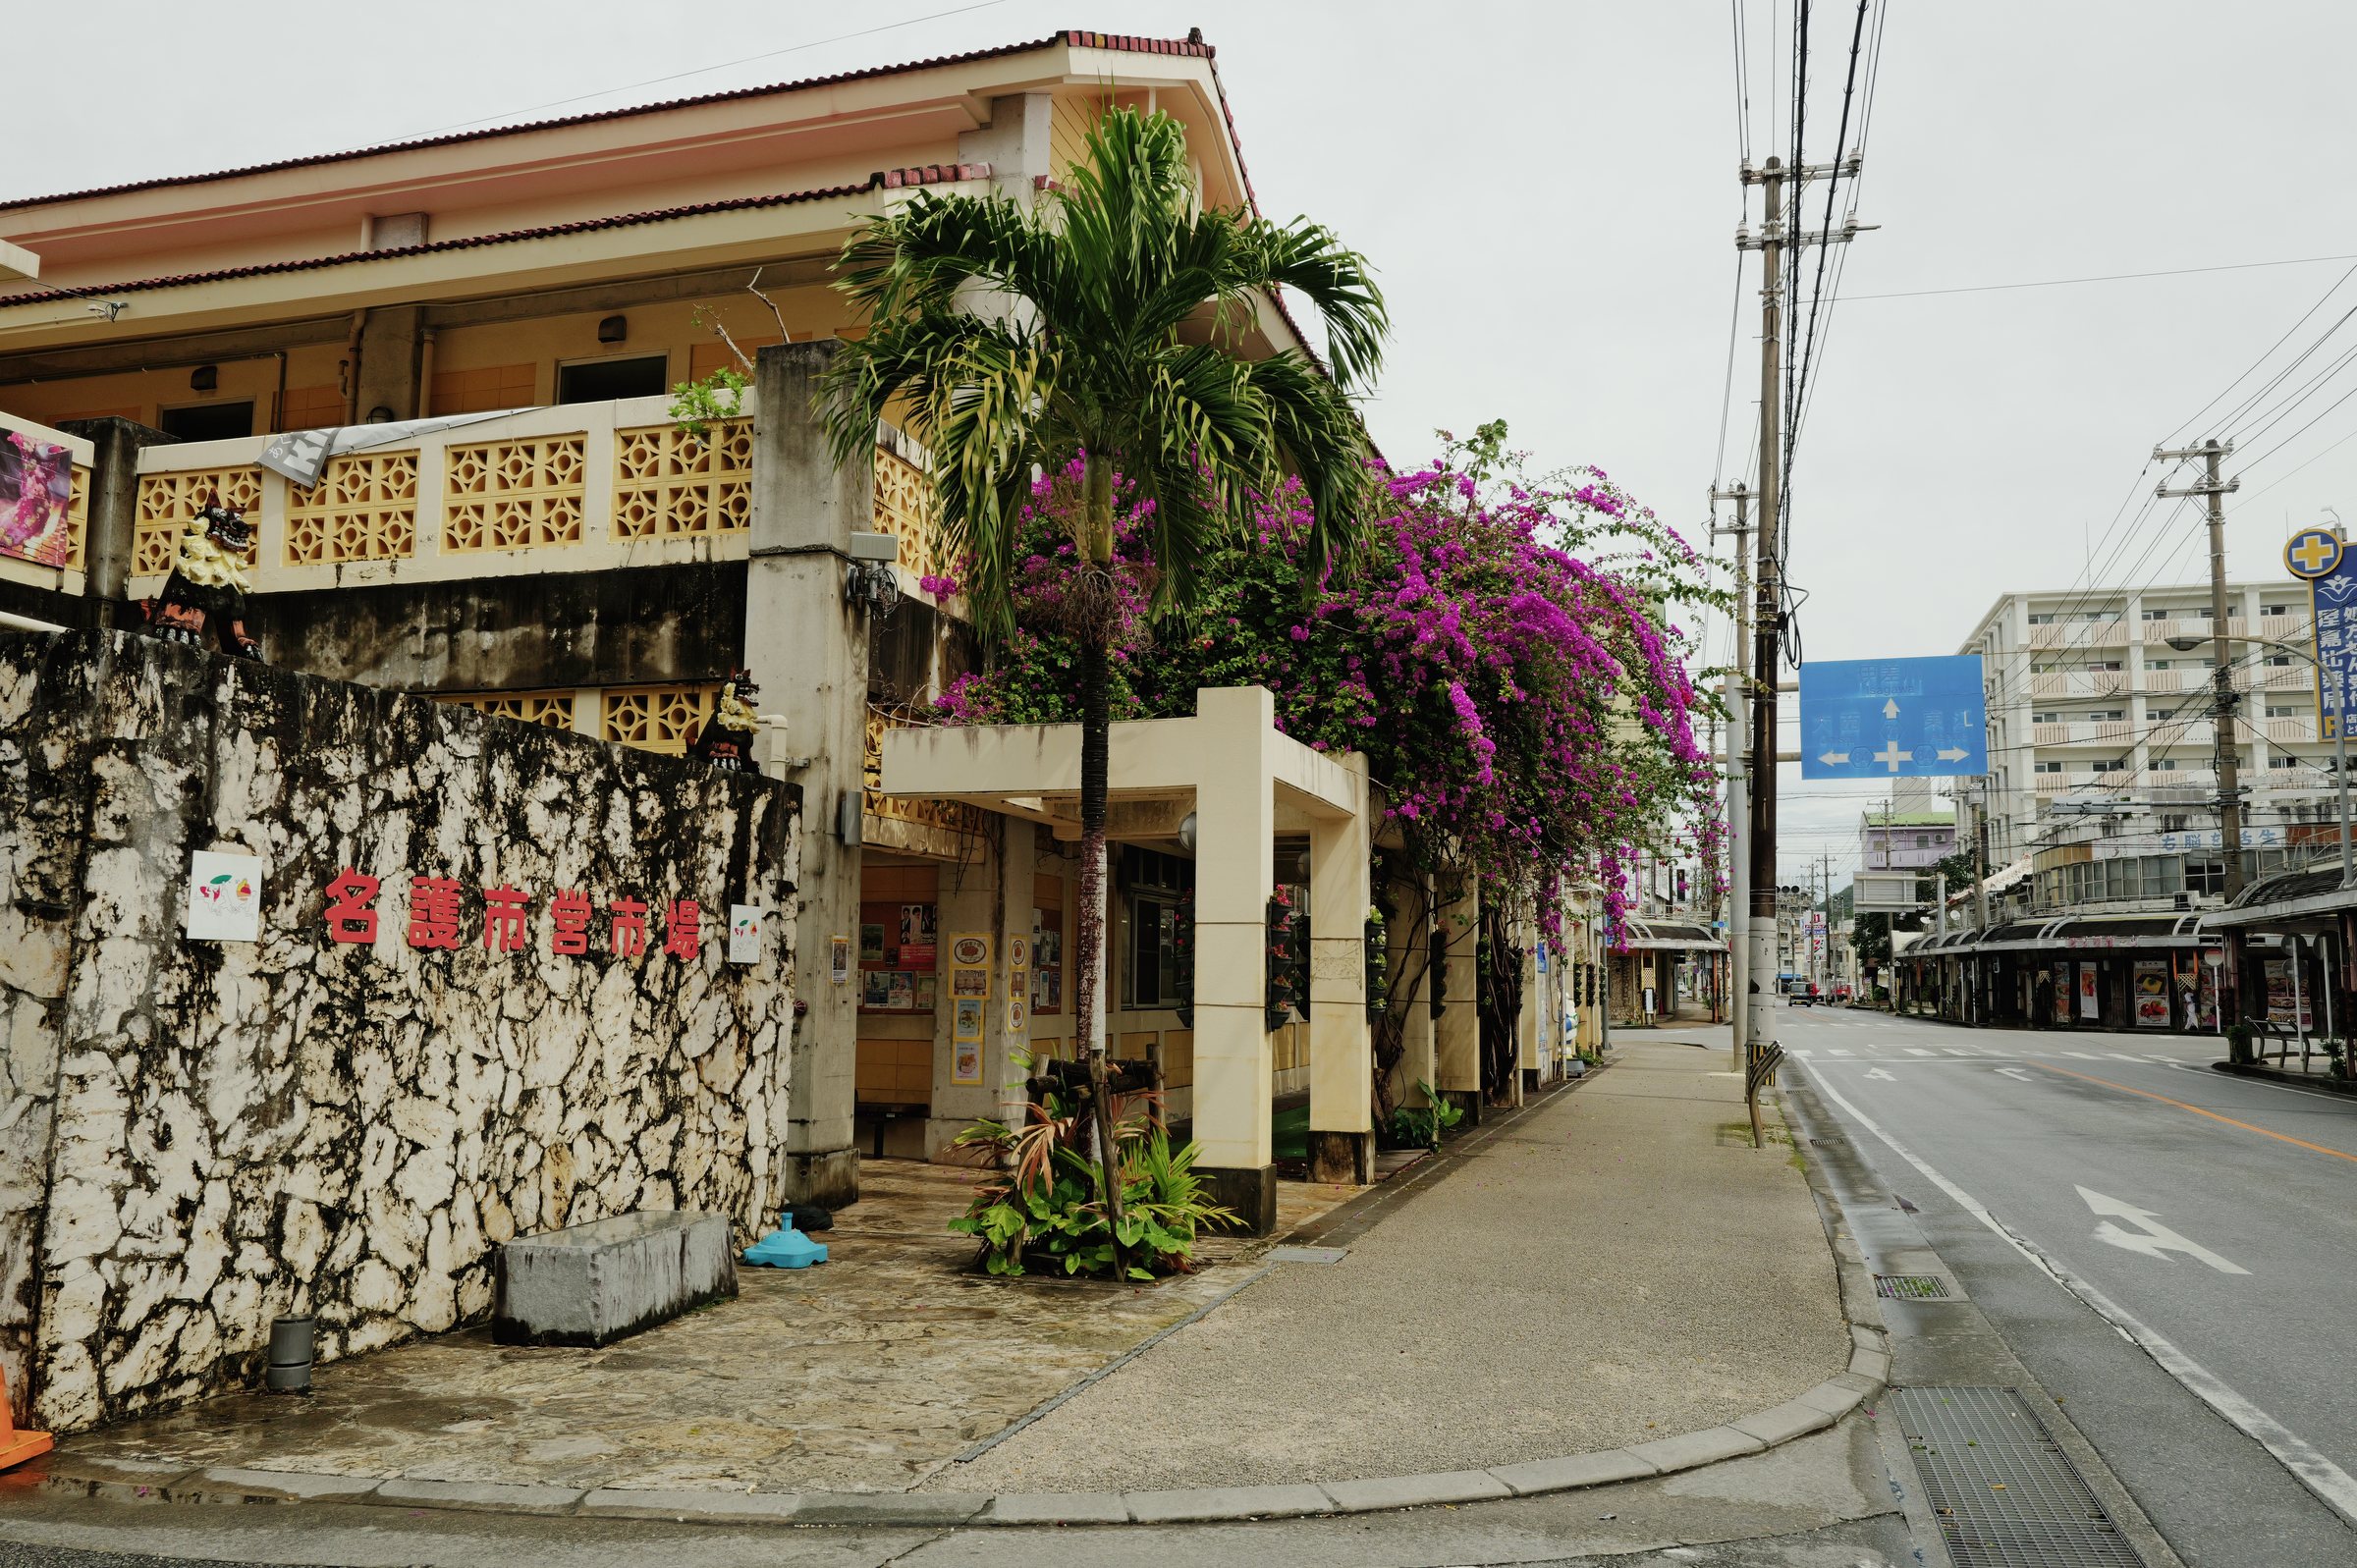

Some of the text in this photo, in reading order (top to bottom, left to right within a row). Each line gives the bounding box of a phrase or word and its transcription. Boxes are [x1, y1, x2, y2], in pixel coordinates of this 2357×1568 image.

[324, 866, 701, 960] 名護市営市場
